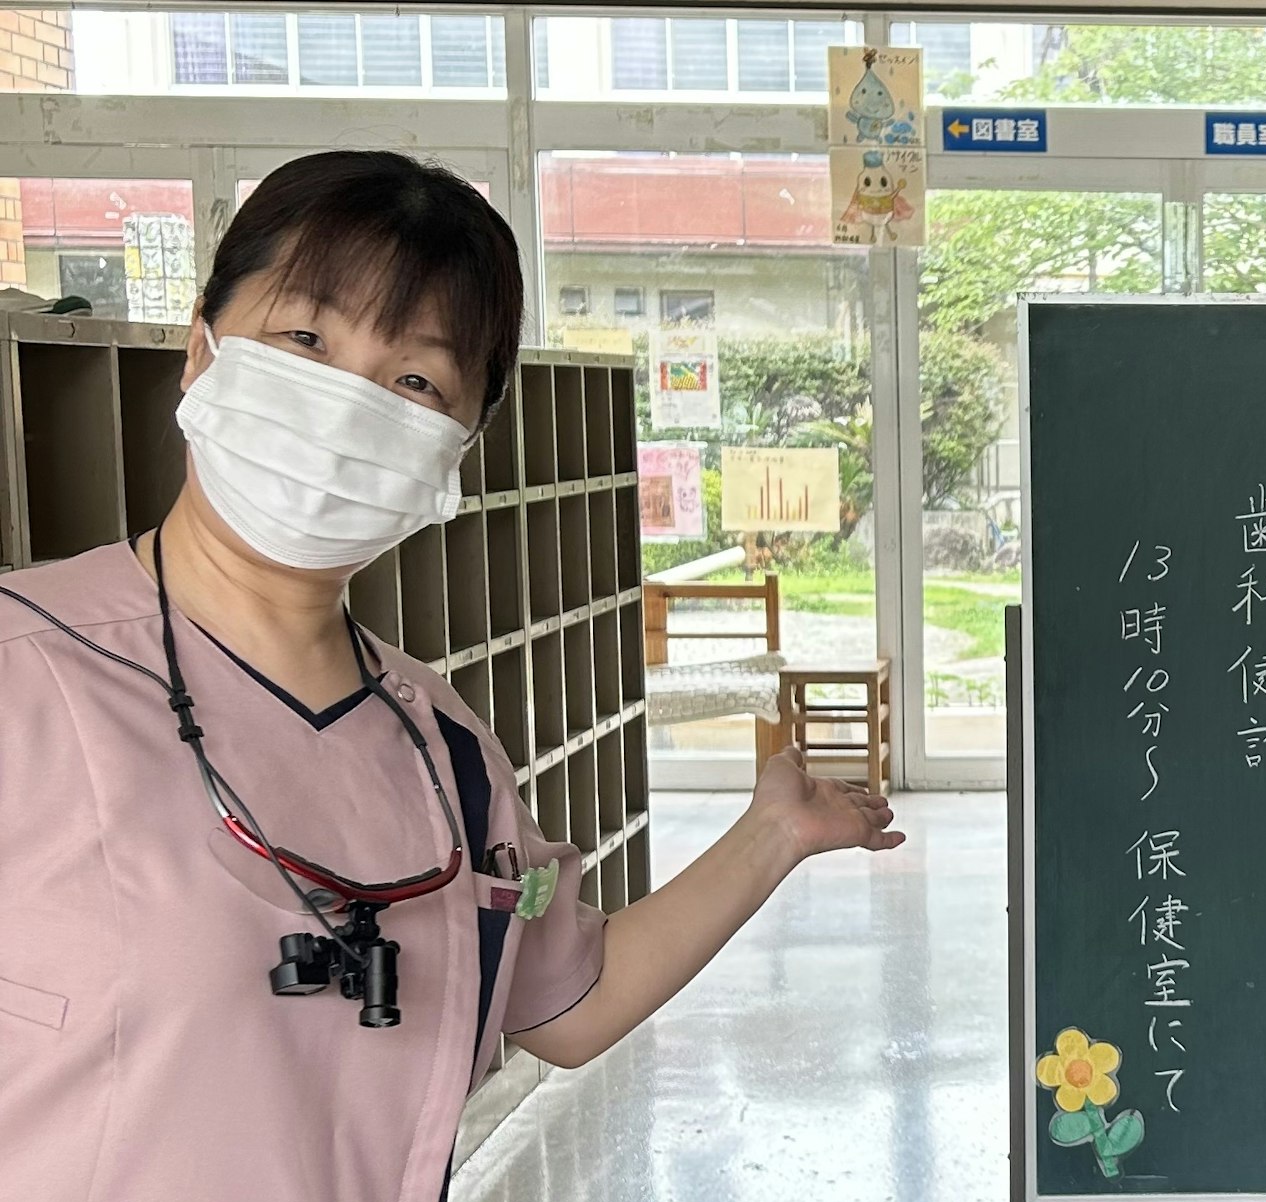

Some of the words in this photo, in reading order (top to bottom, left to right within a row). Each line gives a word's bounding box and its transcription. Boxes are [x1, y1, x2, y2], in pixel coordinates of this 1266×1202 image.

[972, 118, 1039, 141] 図書室
[1125, 829, 1192, 1112] 保健室にて
